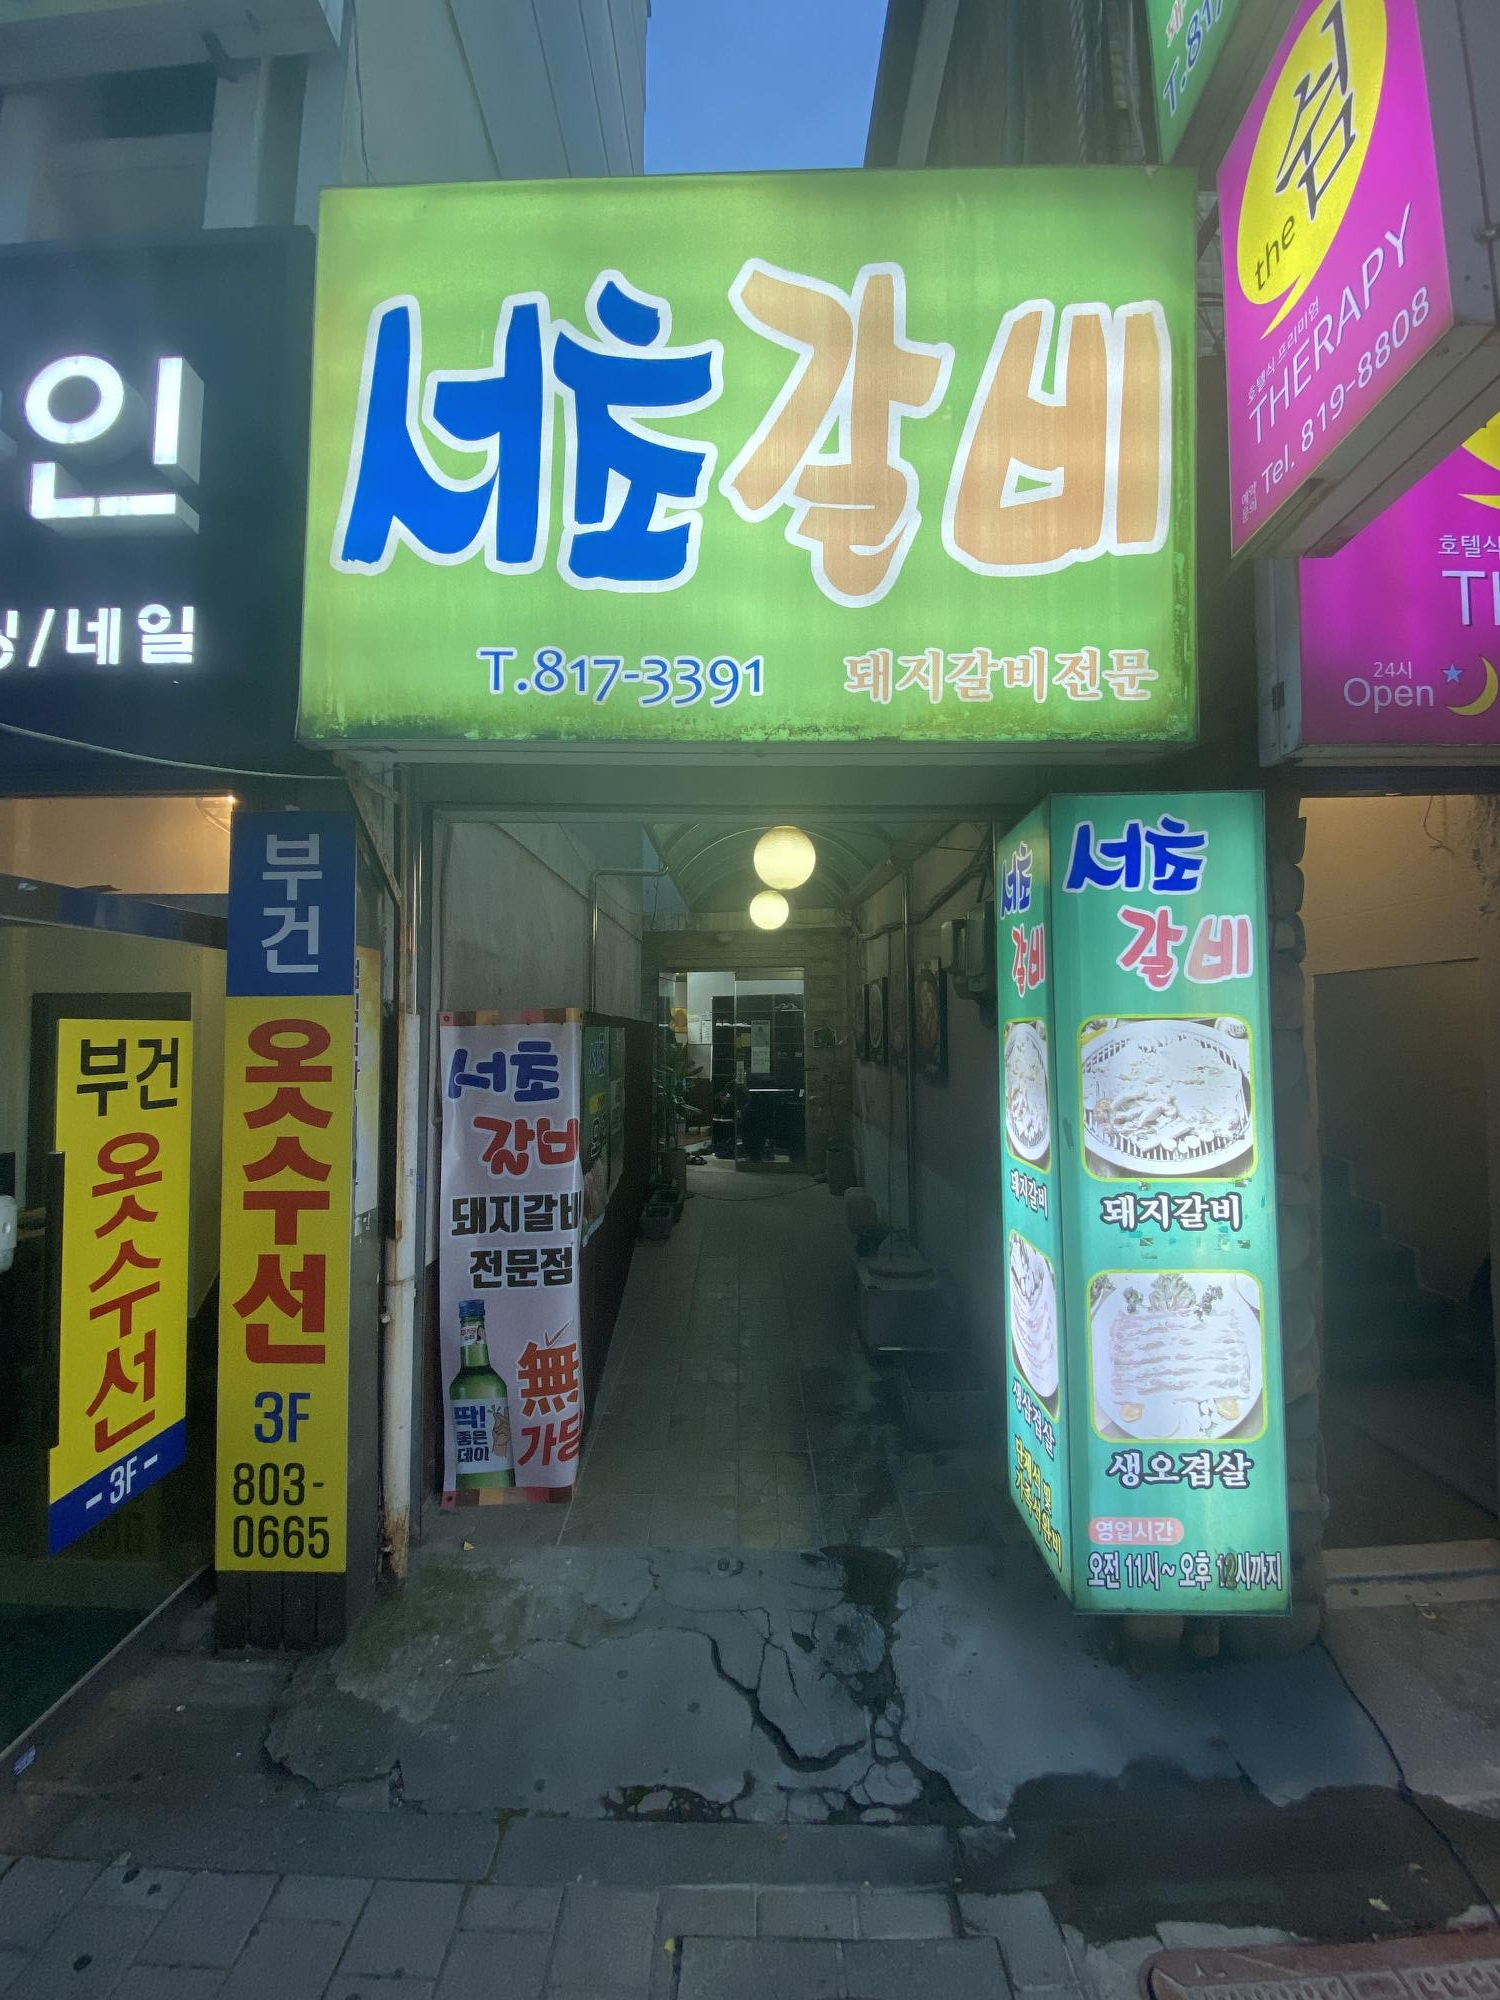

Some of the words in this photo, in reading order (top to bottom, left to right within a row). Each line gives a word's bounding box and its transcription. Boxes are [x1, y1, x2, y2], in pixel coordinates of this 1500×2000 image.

[1254, 215, 1296, 291] the
[1249, 201, 1412, 444] THERAPY
[1261, 444, 1296, 495] Tel.
[1300, 286, 1430, 452] 819-8808
[477, 646, 766, 708] T.817-3391
[843, 647, 1160, 706] 돼지갈비전문
[1343, 677, 1435, 714] Open
[1372, 661, 1413, 680] 24시
[1001, 841, 1034, 920] 서초
[1062, 815, 1209, 895] 서초
[259, 832, 323, 977] 부건
[1011, 923, 1047, 998] 갈비
[1116, 904, 1255, 991] 갈비
[75, 1037, 181, 1118] 부건
[447, 1040, 562, 1103] 서초
[231, 1016, 335, 1366] 옷수선
[451, 1192, 582, 1237] 돼지갈비
[1099, 1190, 1243, 1233] 돼지갈비
[87, 1131, 163, 1454] 옷수선
[468, 1245, 575, 1291] 전문점
[516, 1338, 580, 1419] 無
[252, 1390, 312, 1445] 3F
[1106, 1447, 1256, 1490] 생오겹살
[231, 1513, 331, 1561] 0665
[1095, 1520, 1175, 1543] 영업시간
[1087, 1551, 1121, 1590] 오전
[1178, 1551, 1213, 1591] 오후
